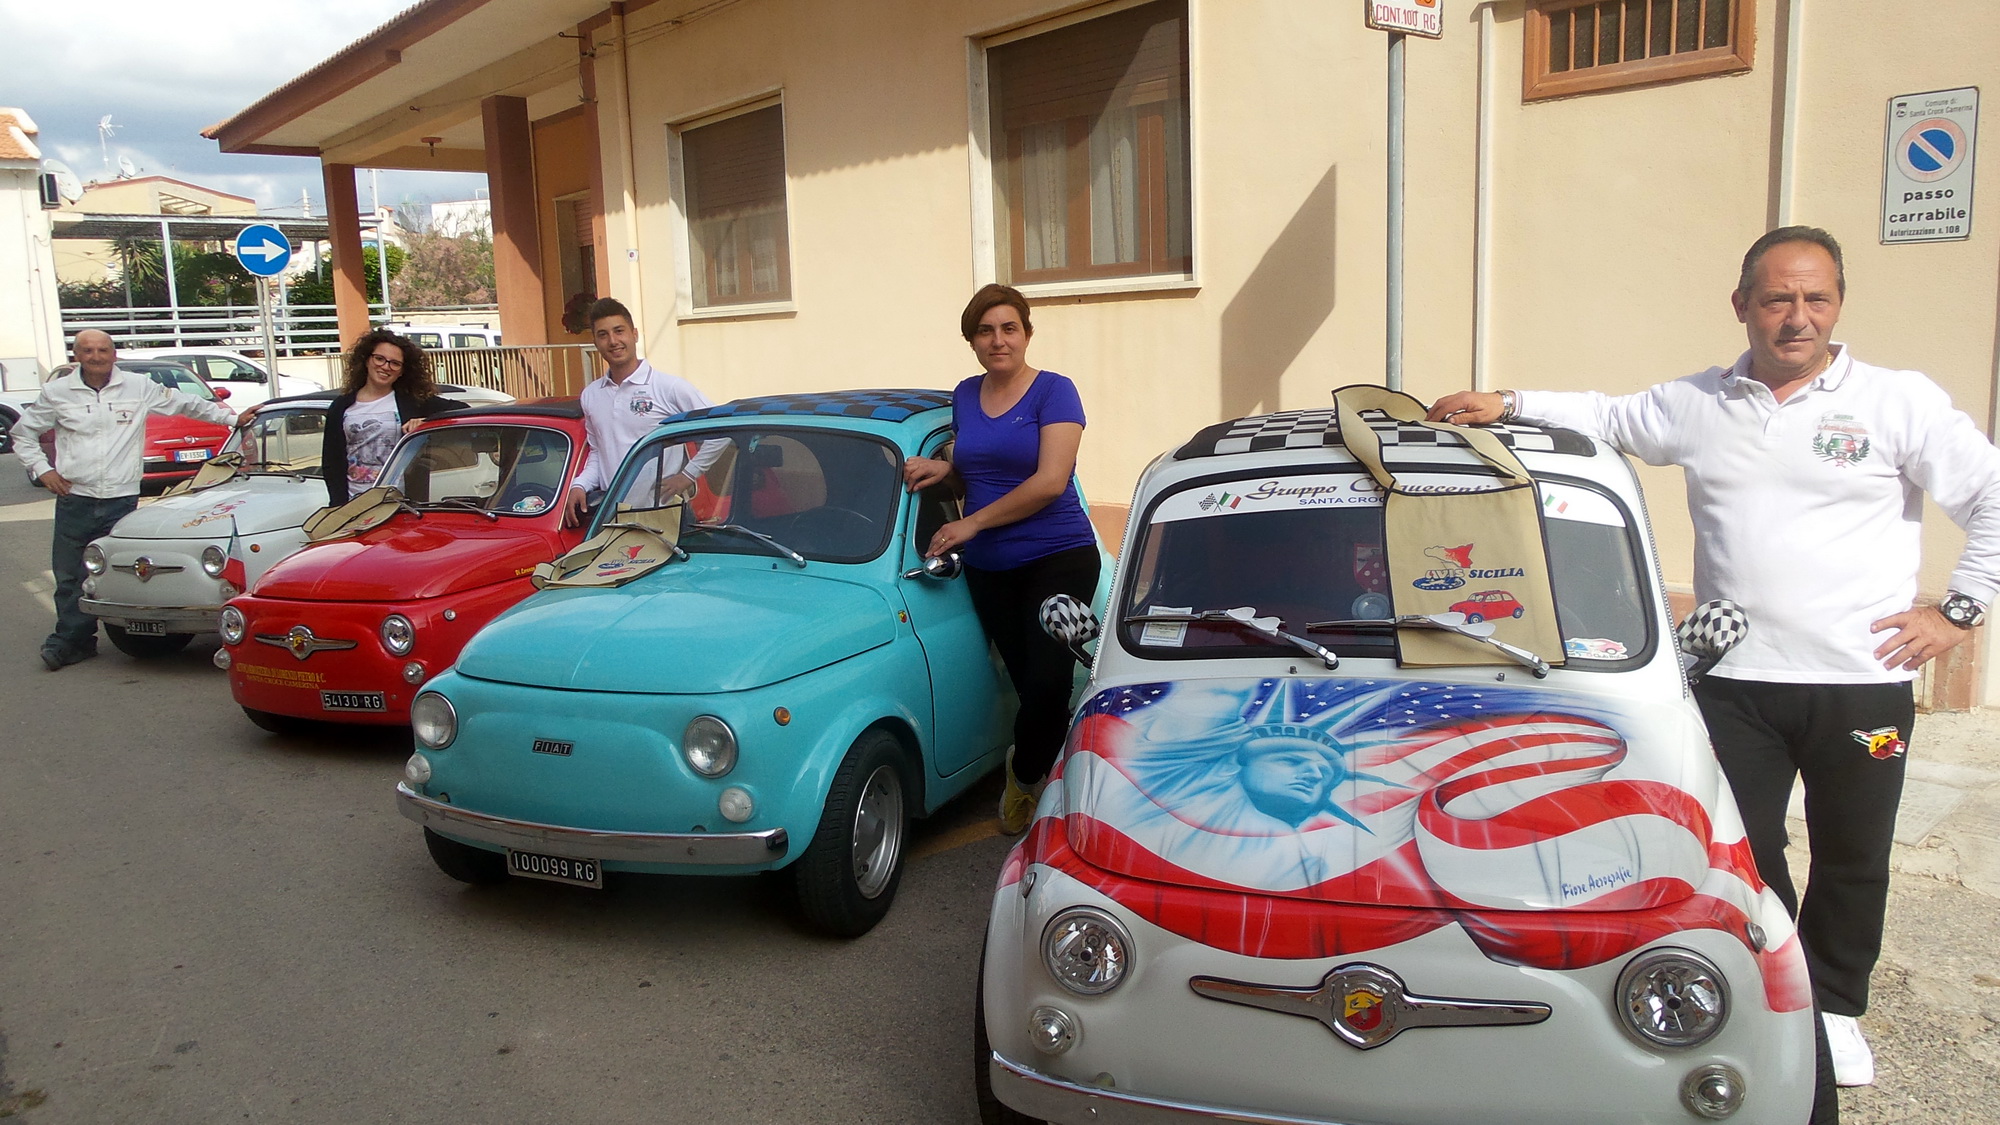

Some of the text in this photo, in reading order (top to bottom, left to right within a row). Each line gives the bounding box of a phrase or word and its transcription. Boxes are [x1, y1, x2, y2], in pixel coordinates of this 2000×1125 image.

[1423, 13, 1436, 30] RG
[1925, 99, 1949, 107] Comune
[1909, 110, 1926, 118] Santa
[1945, 105, 1973, 114] Camerina
[1903, 188, 1954, 204] passo
[1889, 207, 1967, 223] carrabile
[1889, 227, 1936, 237] Autorizzazione
[1245, 481, 1338, 500] Gruppo
[1299, 496, 1385, 505] SANTA CROC
[1468, 567, 1525, 579] SICILIA
[324, 694, 380, 708] 54130 RG
[534, 741, 570, 754] FIAT
[514, 853, 594, 881] 100099 RG
